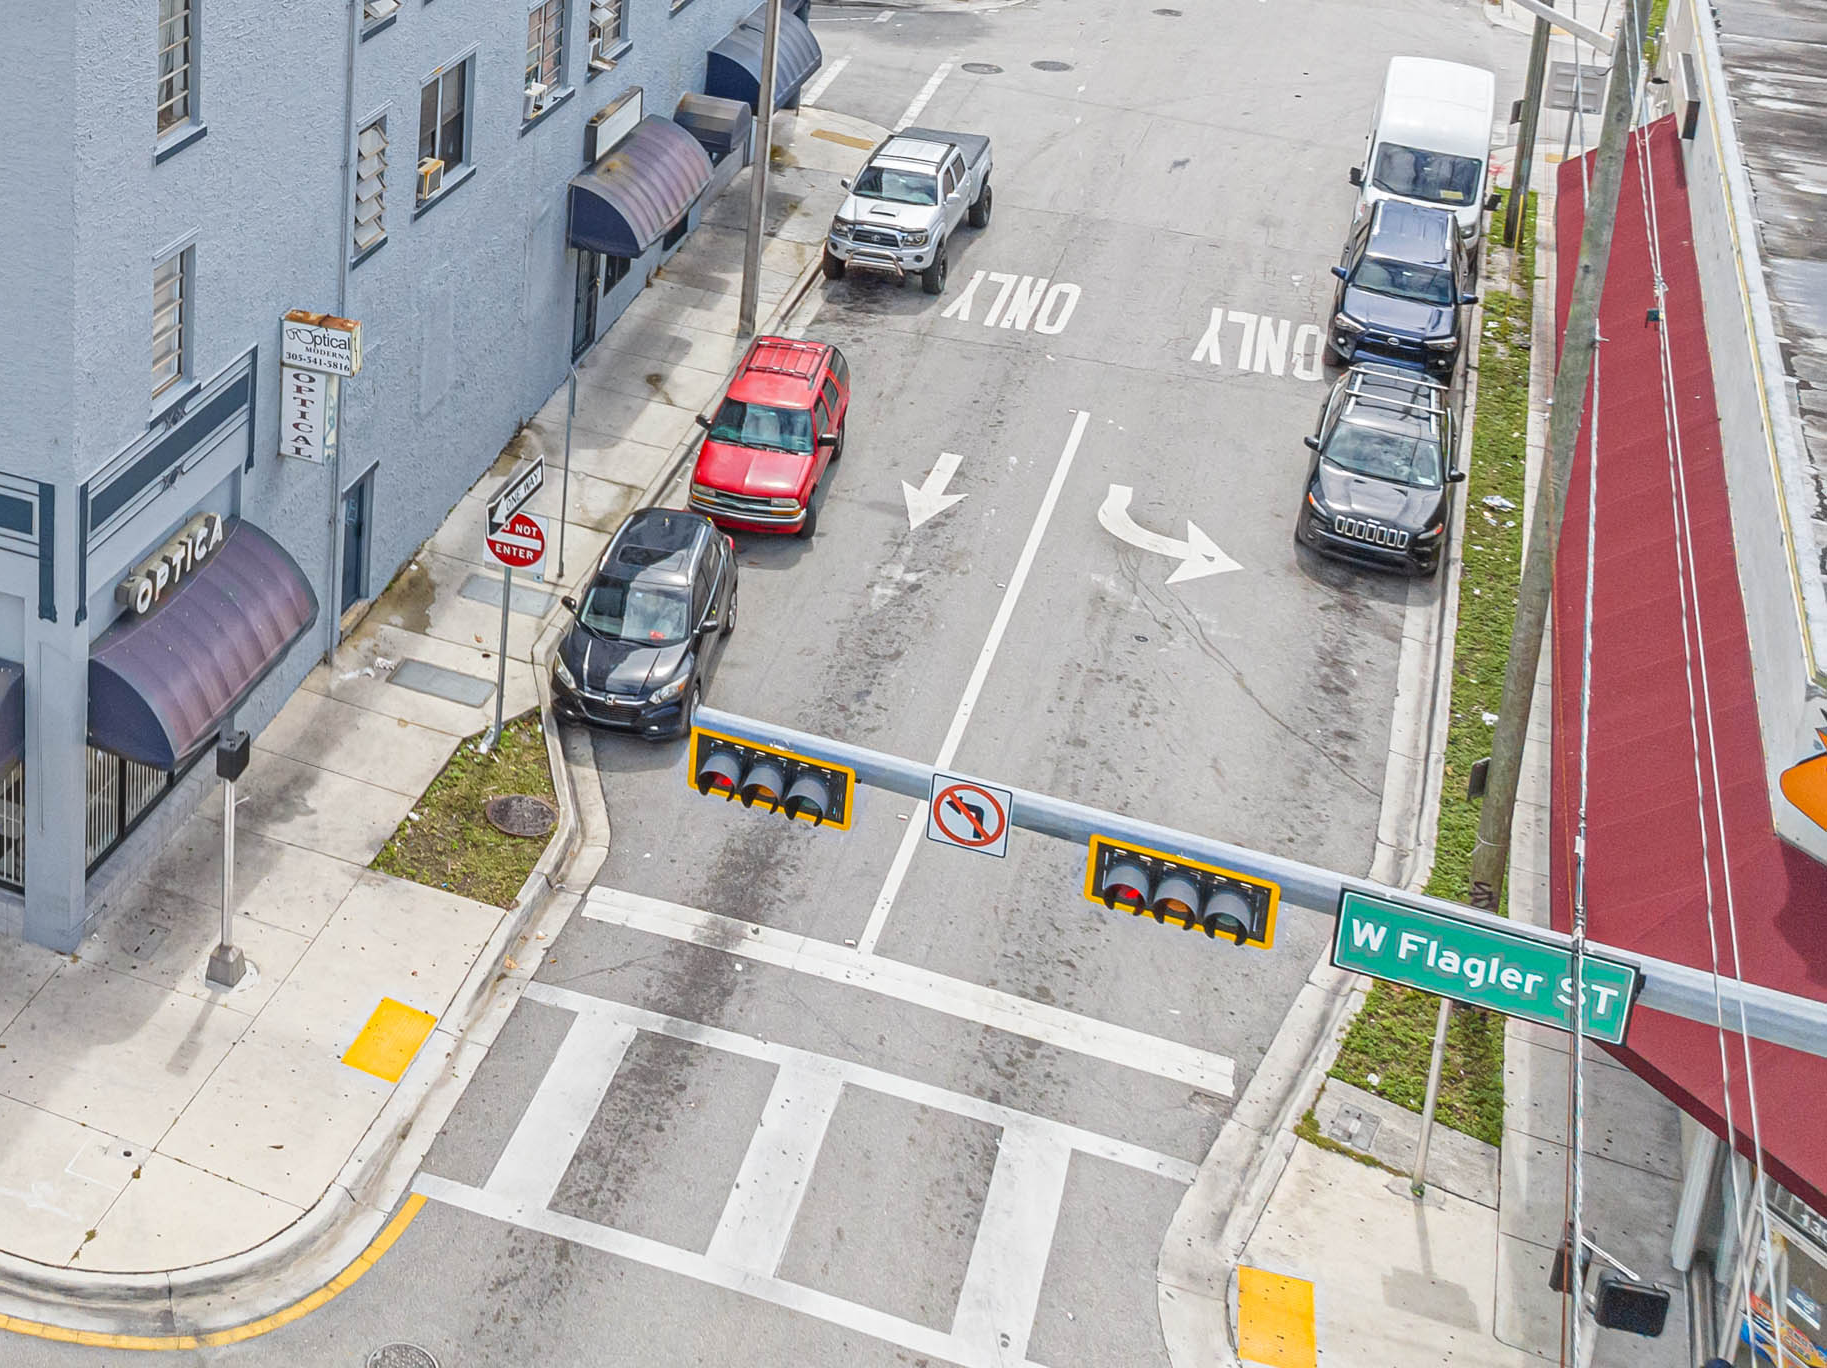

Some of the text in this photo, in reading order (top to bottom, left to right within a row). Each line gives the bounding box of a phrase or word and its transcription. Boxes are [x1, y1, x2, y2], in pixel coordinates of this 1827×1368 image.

[940, 270, 1082, 335] ONLY
[295, 327, 351, 351] Optical
[305, 346, 350, 361] MODERNA
[1191, 307, 1326, 382] ONLY
[285, 351, 350, 371] 305-541-5816
[290, 372, 316, 459] OPTICAL
[505, 470, 540, 512] ONE WAY
[515, 523, 539, 537] NOT
[136, 513, 223, 615] OPTICA
[495, 543, 534, 561] ENTER
[1352, 918, 1619, 1015] W Flagler ST
